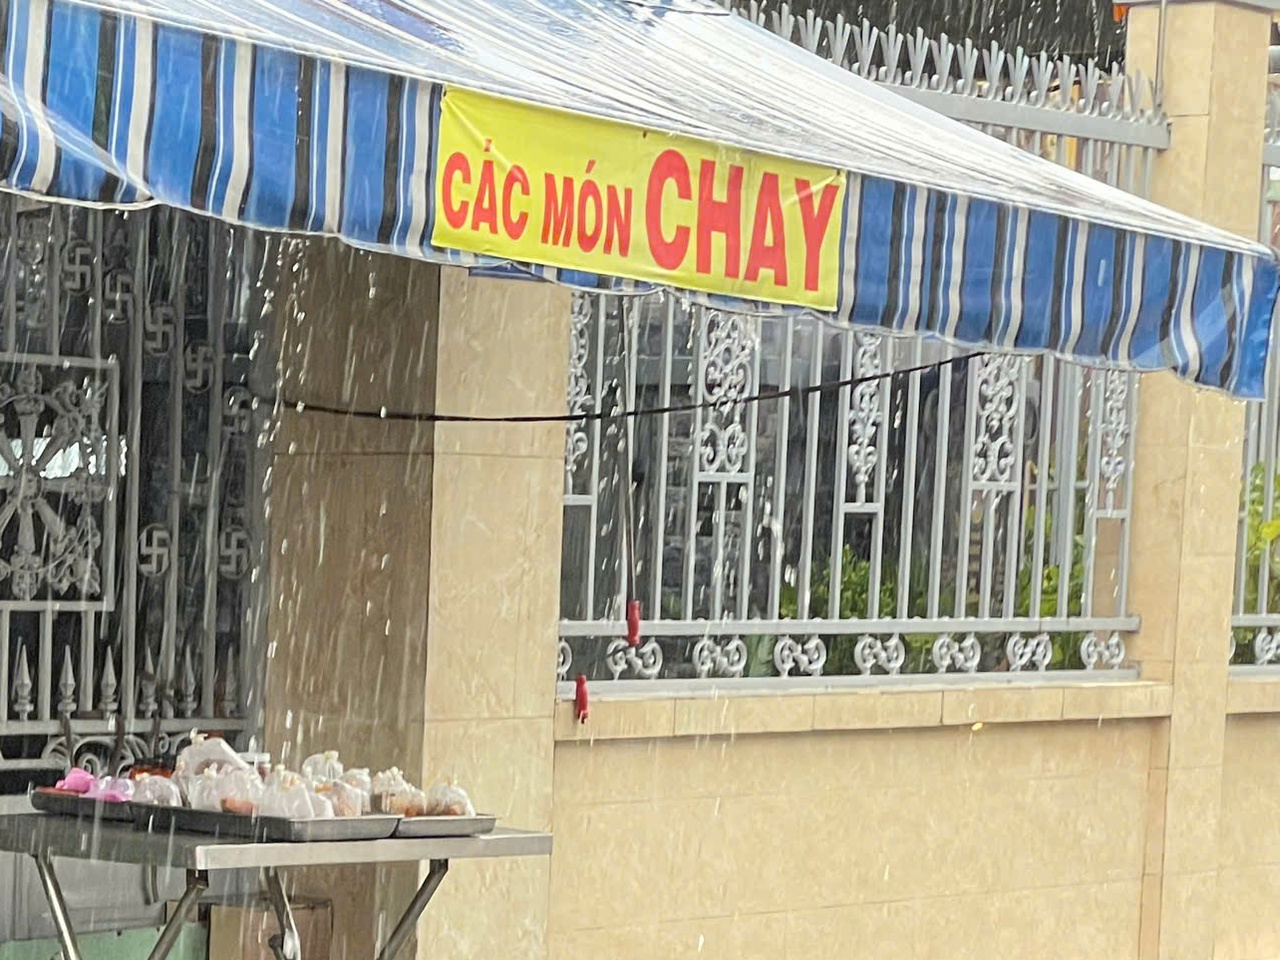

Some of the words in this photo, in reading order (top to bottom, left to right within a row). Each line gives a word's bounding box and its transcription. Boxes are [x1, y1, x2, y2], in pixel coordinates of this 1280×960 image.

[441, 138, 531, 241] CÁC
[540, 159, 634, 258] MÓN
[644, 148, 840, 292] CHAY
